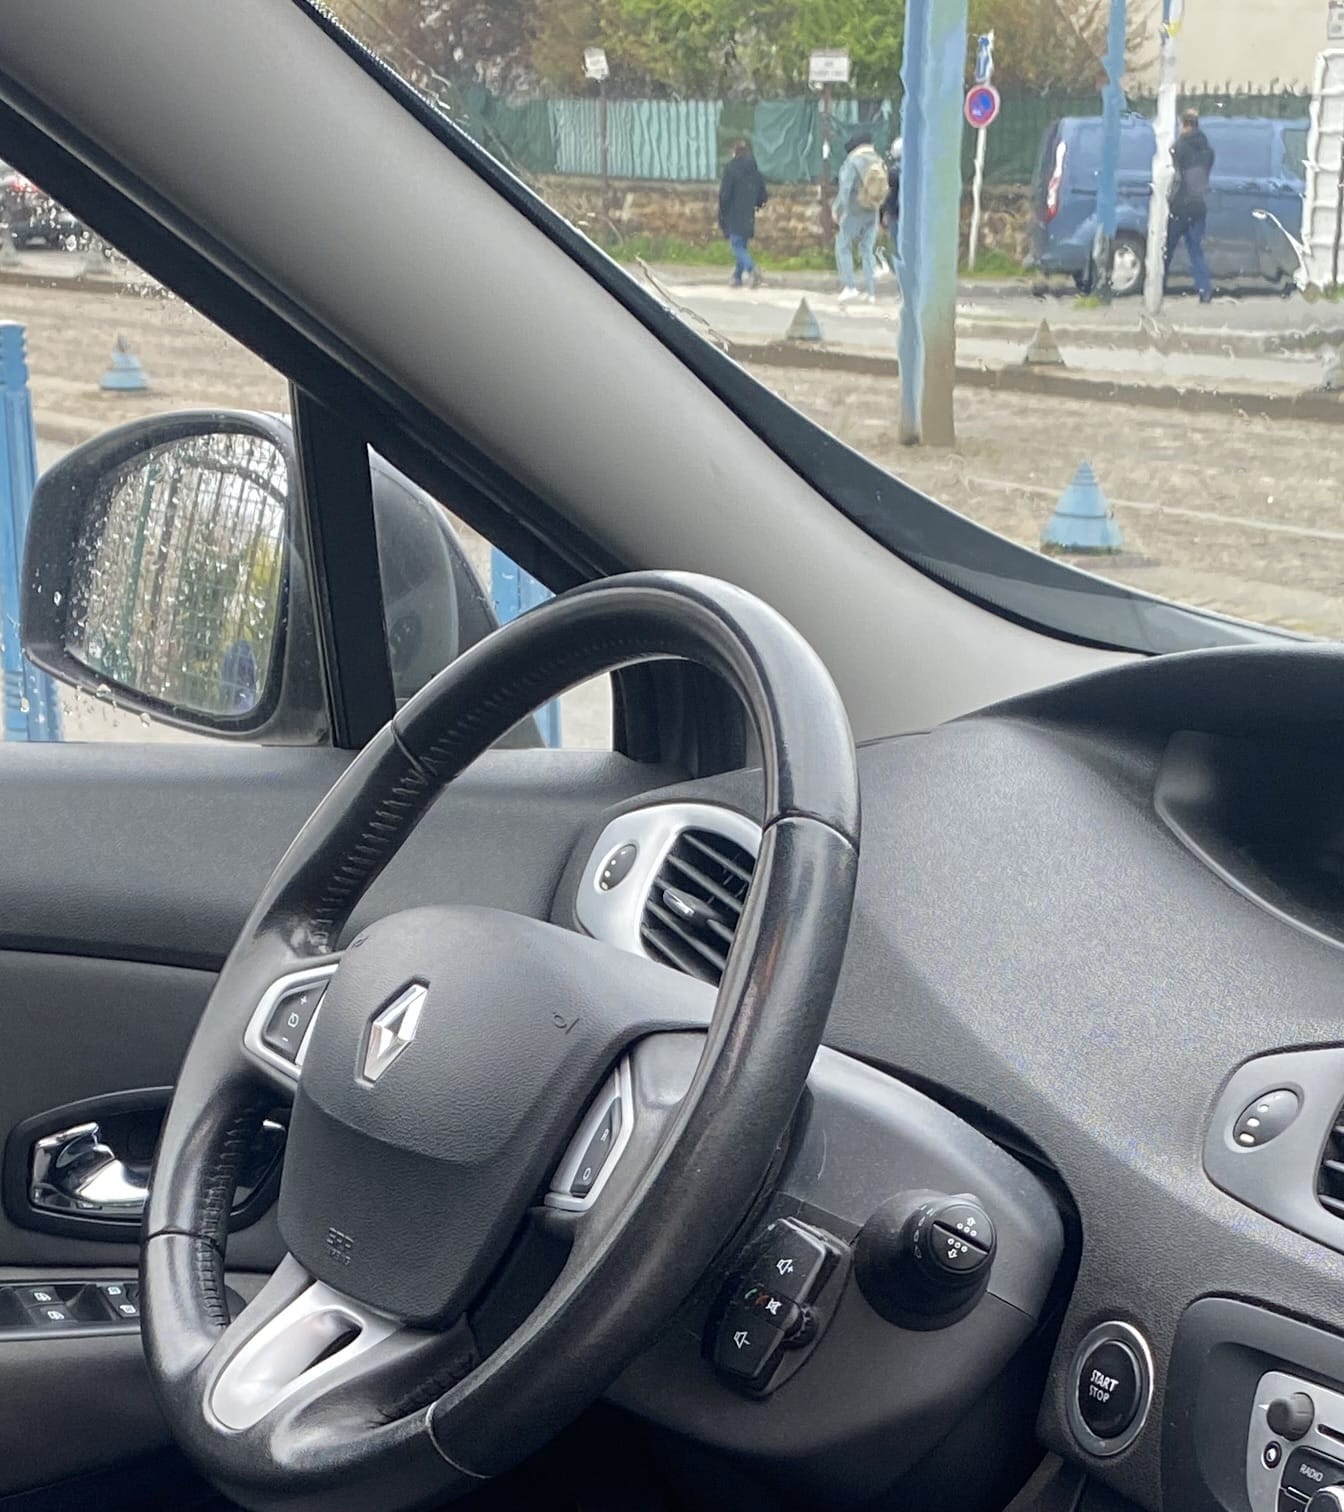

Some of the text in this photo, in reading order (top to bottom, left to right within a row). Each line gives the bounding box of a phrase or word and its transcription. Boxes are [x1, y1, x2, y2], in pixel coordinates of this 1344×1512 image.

[1090, 1369, 1120, 1392] START
[1089, 1384, 1110, 1403] STOP
[1299, 1463, 1324, 1482] RADIO
